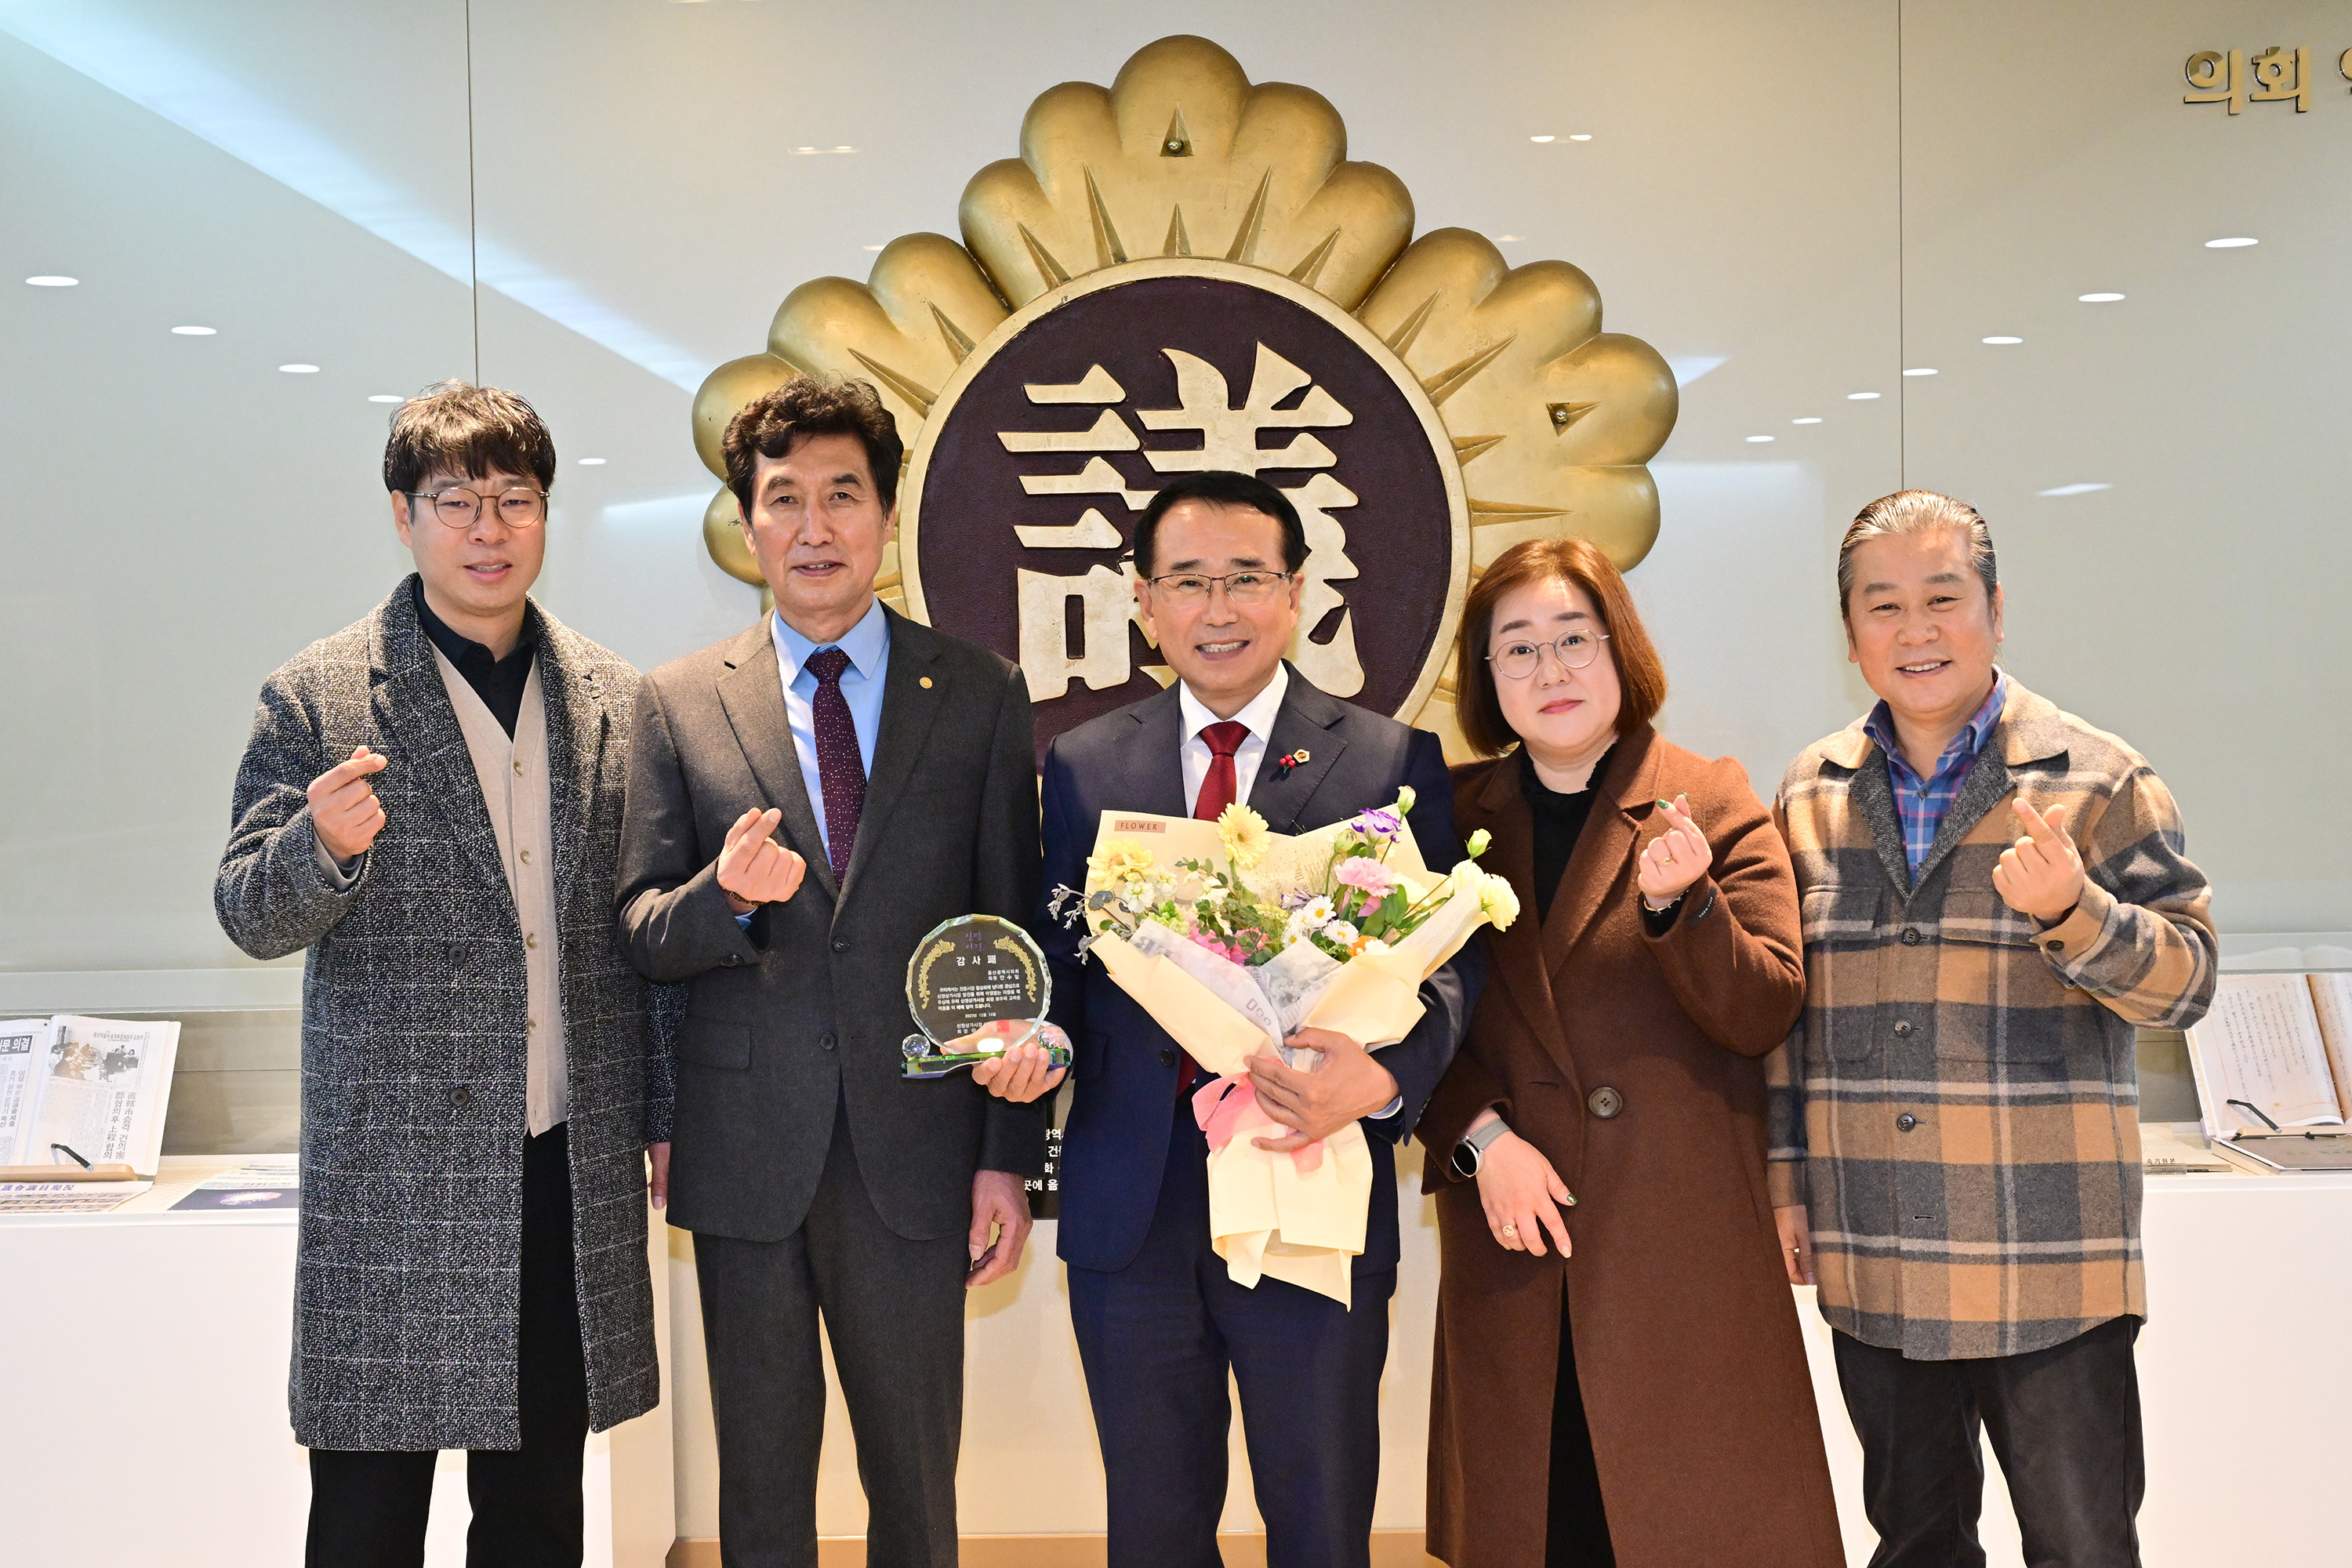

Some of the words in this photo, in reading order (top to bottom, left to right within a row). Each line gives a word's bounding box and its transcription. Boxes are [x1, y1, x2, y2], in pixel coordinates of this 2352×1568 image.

[2183, 45, 2311, 115] 의회
[1120, 822, 1157, 830] FLOWER
[12, 1036, 31, 1051] 의결
